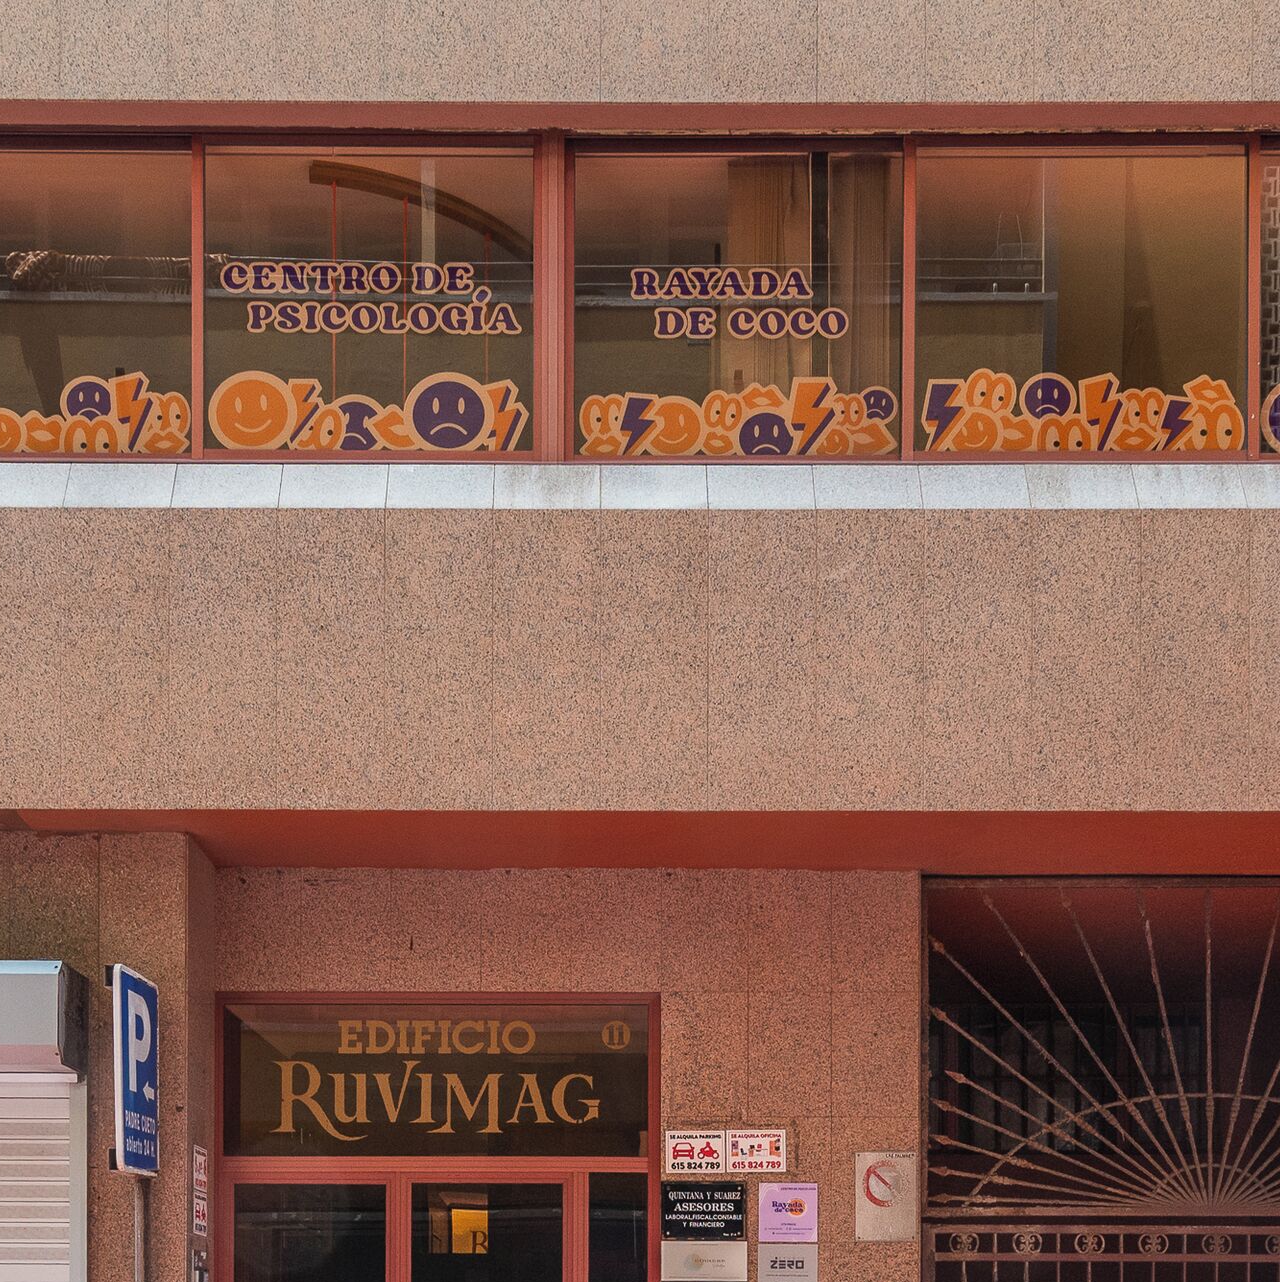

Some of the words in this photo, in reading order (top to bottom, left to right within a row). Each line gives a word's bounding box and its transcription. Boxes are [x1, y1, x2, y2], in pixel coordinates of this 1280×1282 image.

[221, 263, 400, 293] CENTRO
[413, 263, 473, 293] DE
[632, 269, 812, 298] RAYADA
[248, 287, 522, 334] PSICOLOGÍA
[655, 309, 715, 337] DE
[728, 308, 848, 338] COCO
[127, 989, 152, 1093] P
[337, 1020, 537, 1054] EDIFICIO
[671, 1162, 685, 1170] 615
[687, 1162, 703, 1170] 824
[704, 1162, 720, 1170] 789
[732, 1161, 746, 1169] 615
[748, 1161, 764, 1169] 824
[766, 1161, 782, 1169] 789
[668, 1191, 704, 1200] QUINTANA
[706, 1192, 712, 1200] Y
[714, 1192, 741, 1200] SUAREZ
[674, 1202, 734, 1212] ASESORES
[772, 1200, 803, 1209] Rayada
